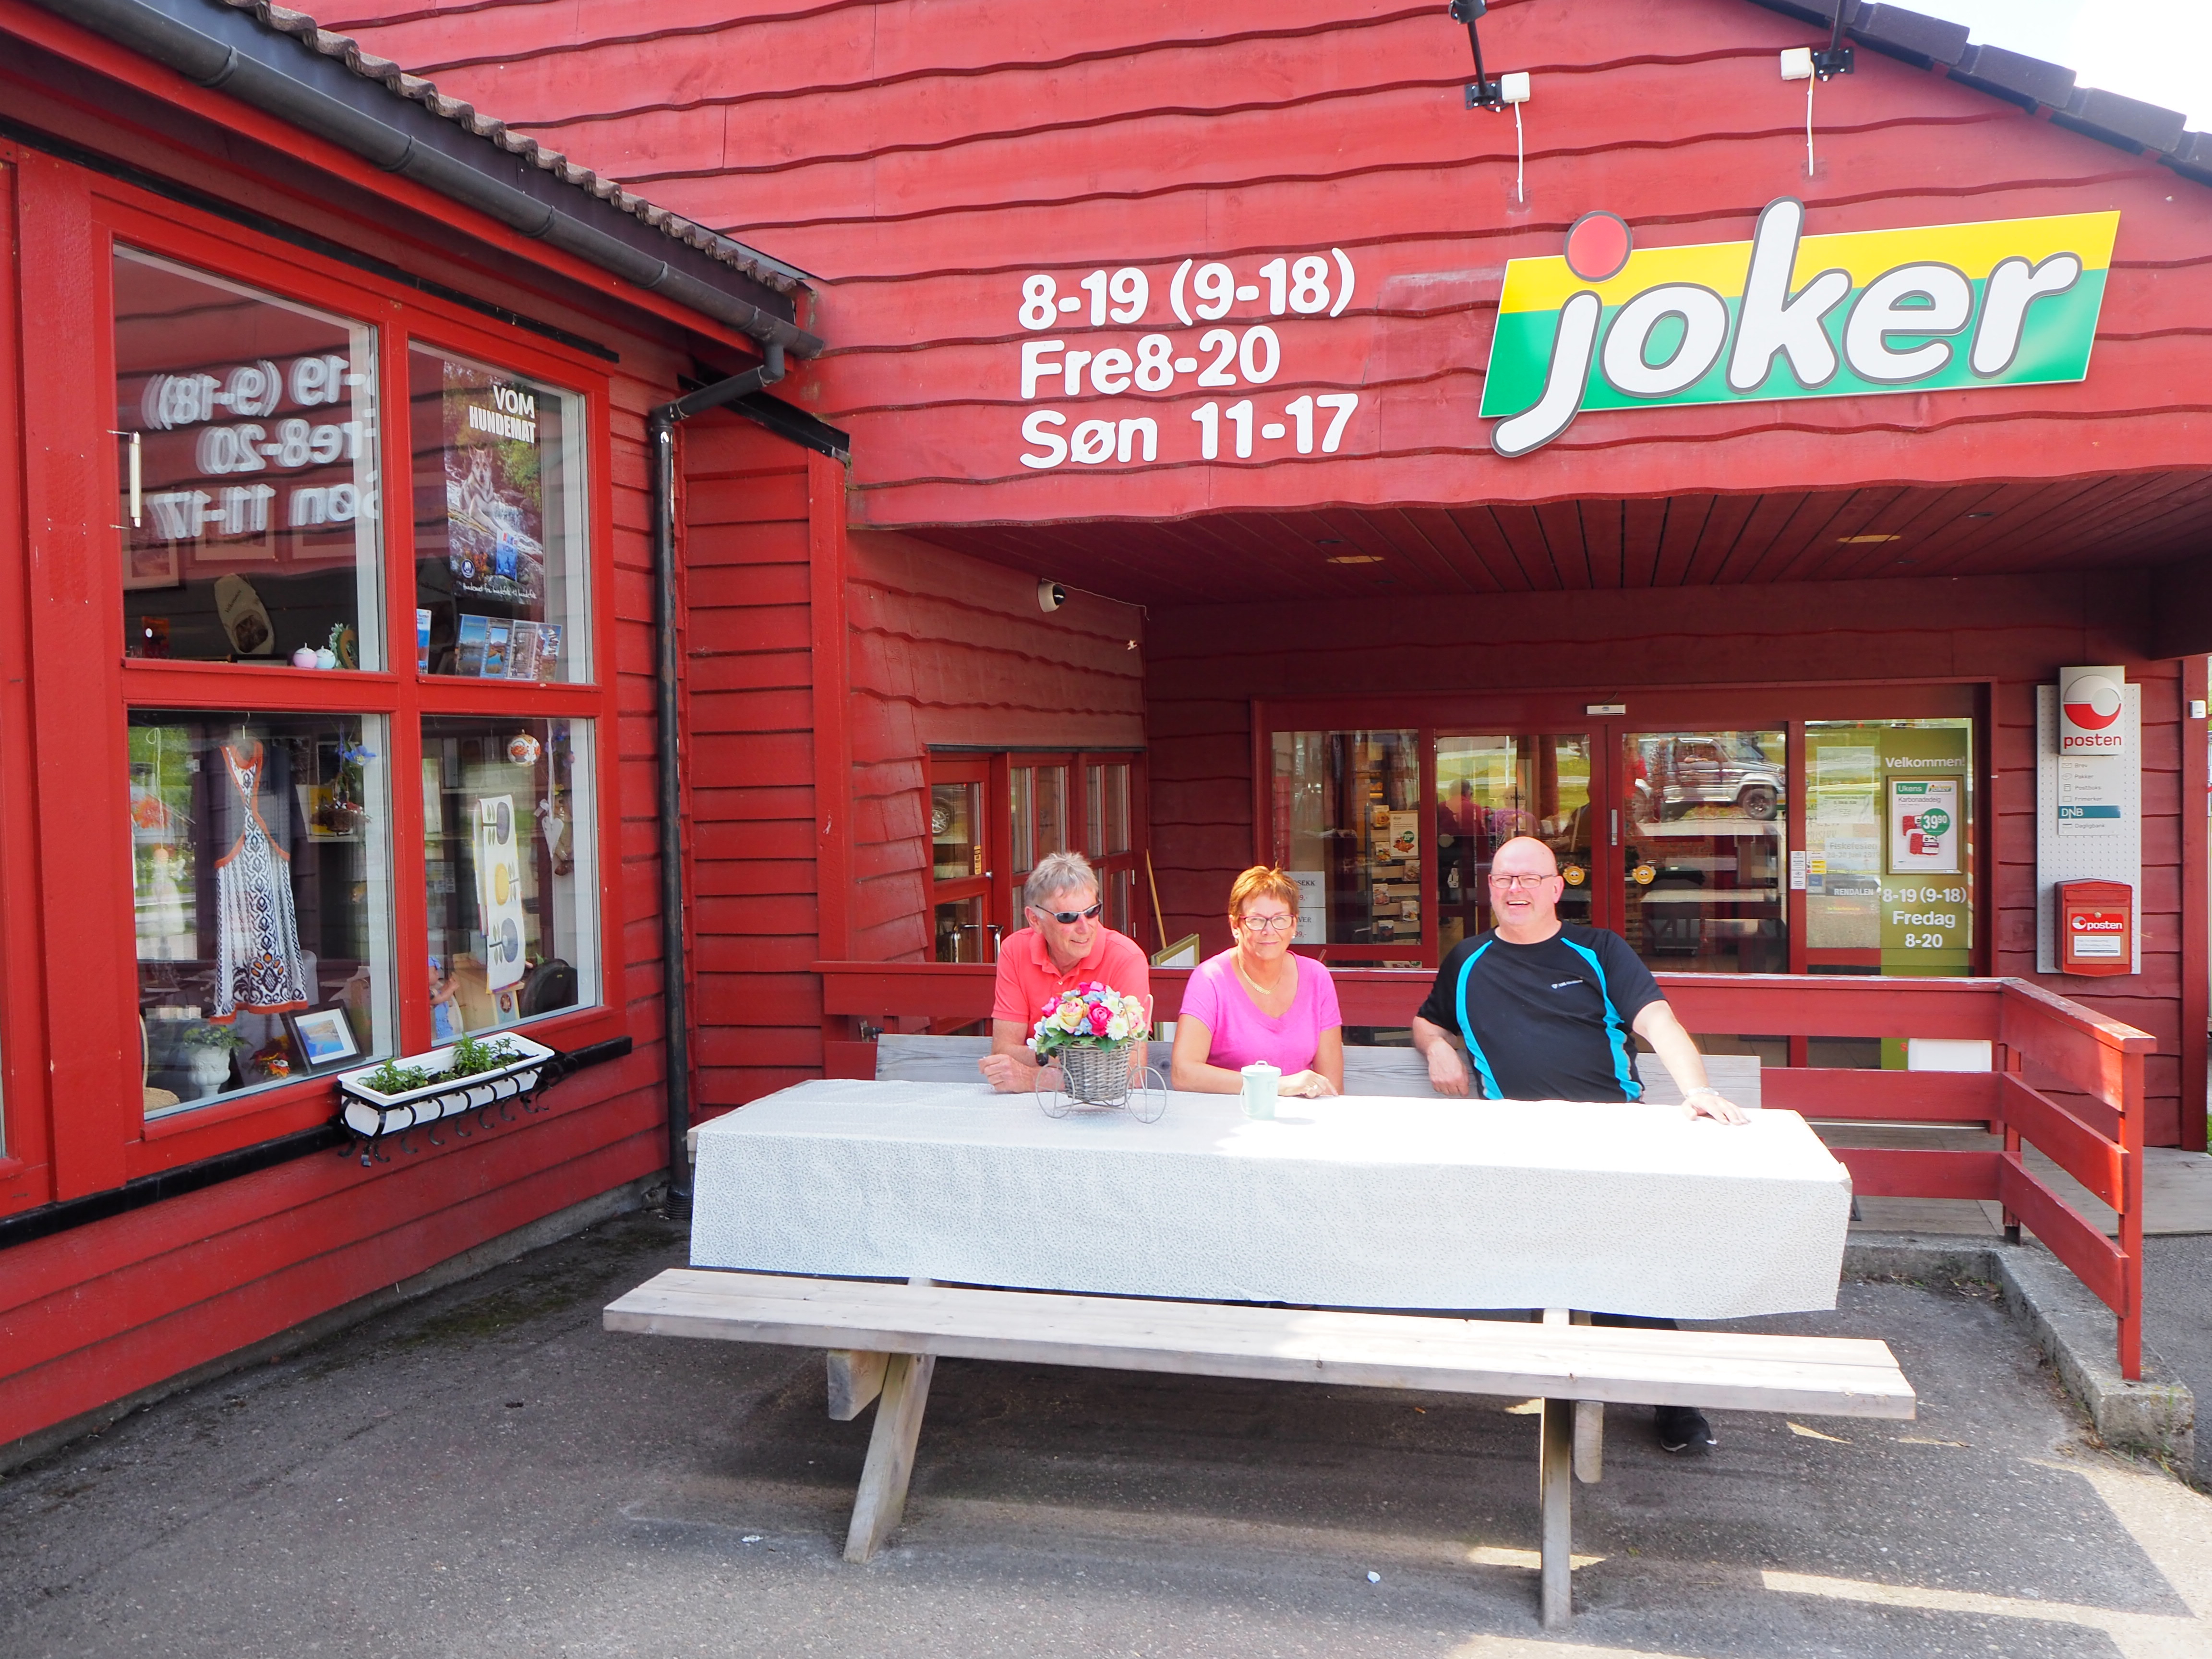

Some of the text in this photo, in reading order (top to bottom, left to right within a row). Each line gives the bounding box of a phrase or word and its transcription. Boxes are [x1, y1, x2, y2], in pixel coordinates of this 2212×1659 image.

[1018, 247, 1356, 330] 8-19 (9-18)
[1491, 196, 2083, 457] joker
[1021, 325, 1281, 399] Fre8-20
[493, 385, 535, 419] VOM
[469, 405, 536, 444] HUNDEMAT
[1020, 393, 1359, 469] Søn 11-17
[2064, 733, 2122, 749] posten
[1885, 757, 1966, 768] Velkommen!
[2061, 806, 2083, 819] DNB
[1882, 887, 1967, 903] 8-19 (9-18)
[1893, 910, 1956, 928] Fredag
[2087, 920, 2123, 931] posten
[1905, 933, 1943, 948] 8-20
